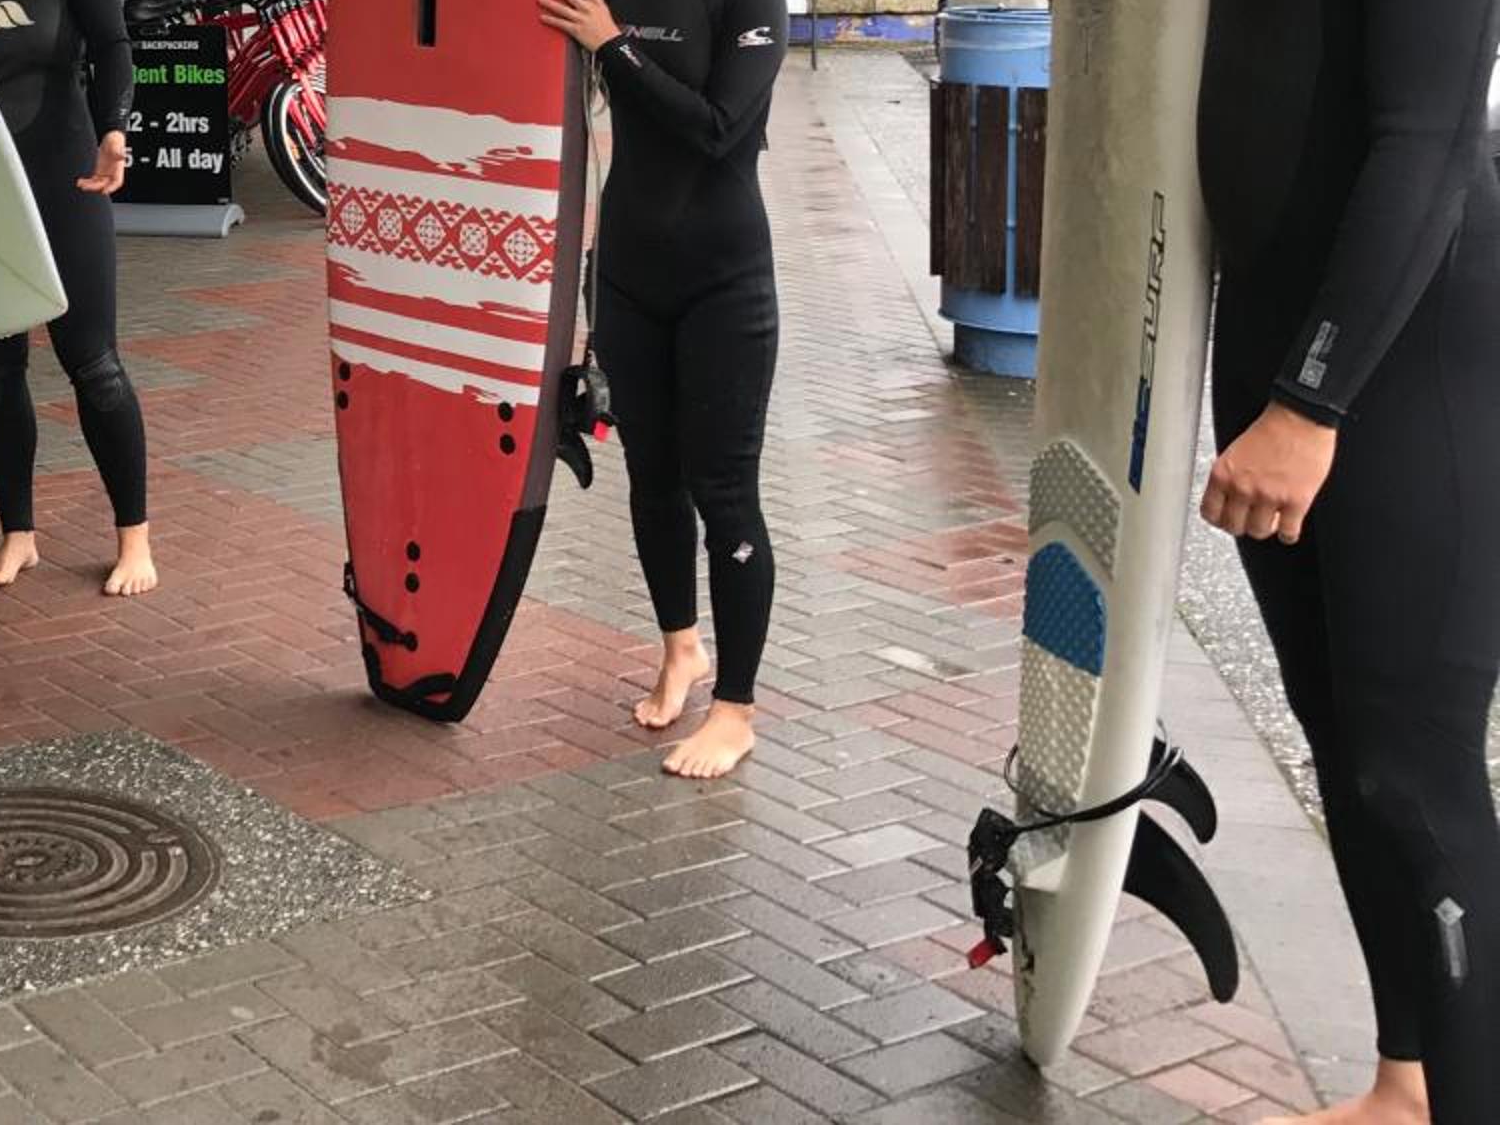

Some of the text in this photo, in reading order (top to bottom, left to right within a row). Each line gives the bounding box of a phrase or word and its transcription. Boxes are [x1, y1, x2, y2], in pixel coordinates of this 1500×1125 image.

[174, 64, 226, 84] Bikes
[166, 111, 210, 133] 2hrs
[156, 147, 182, 168] All
[188, 148, 224, 174] day
